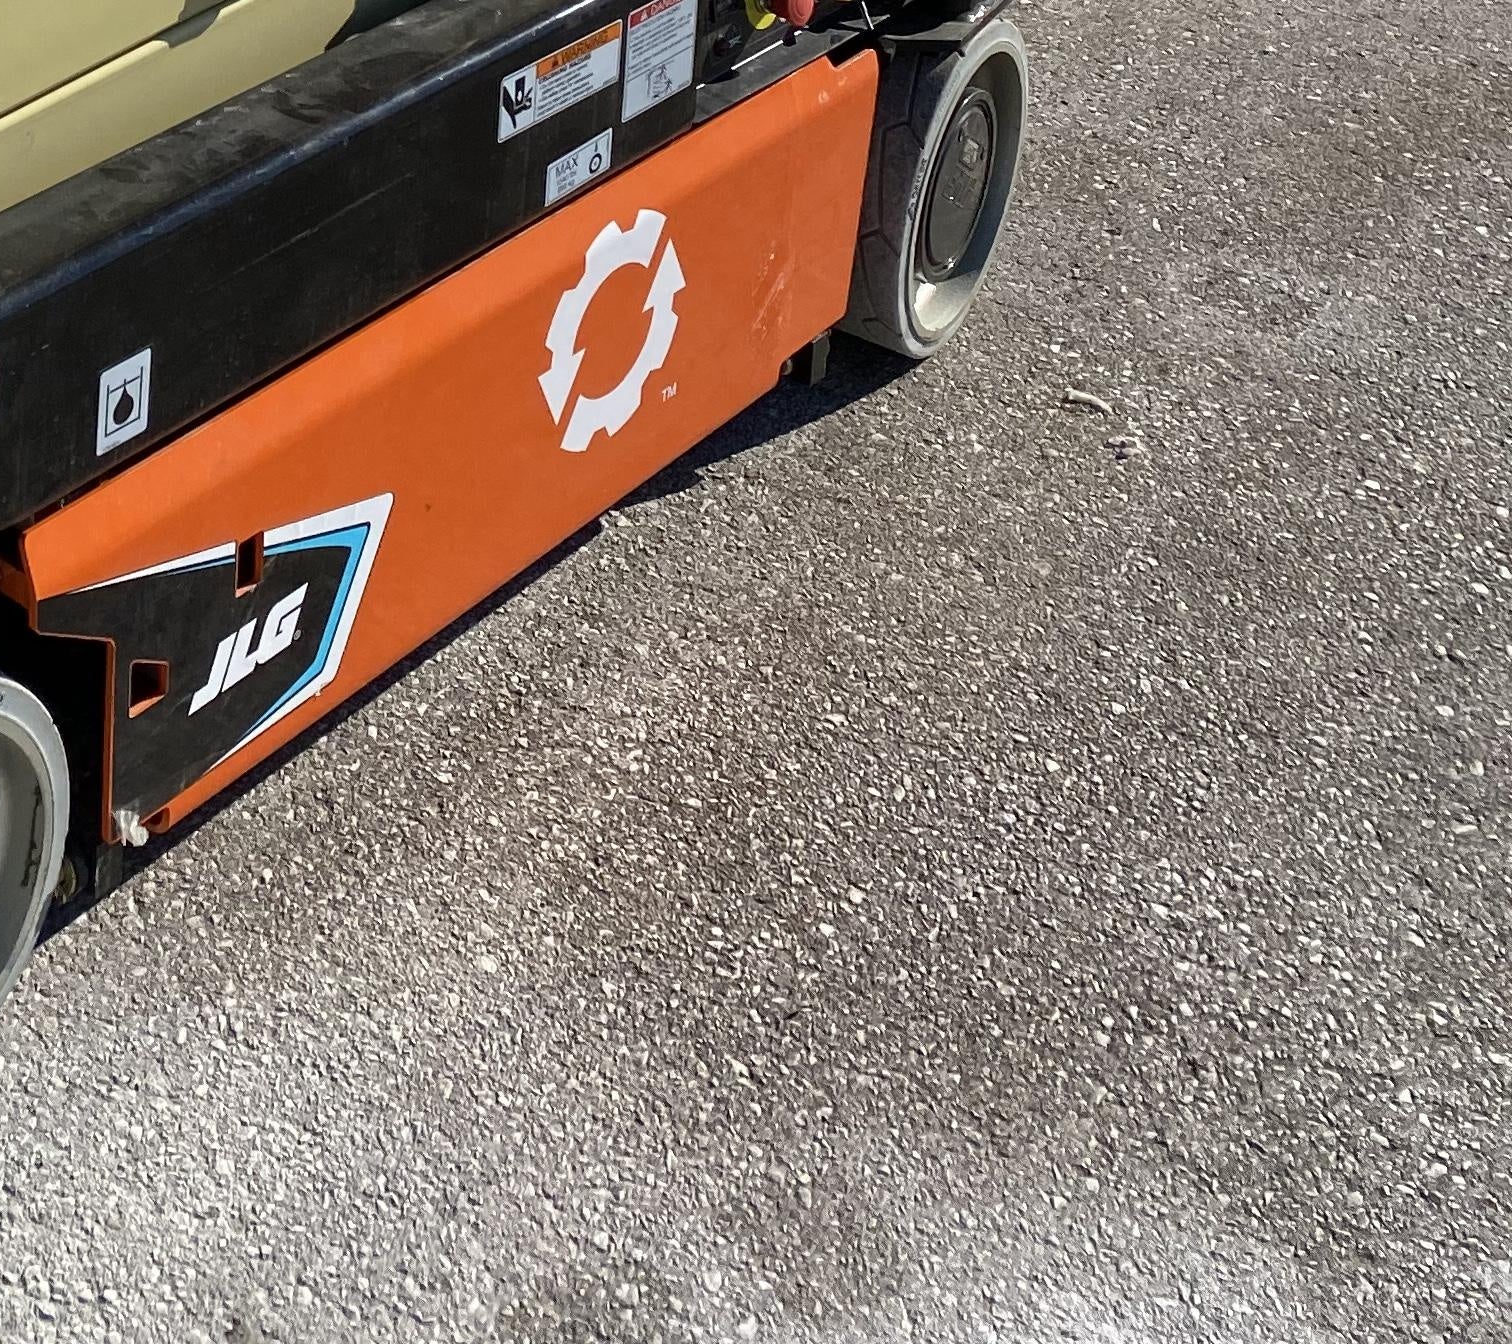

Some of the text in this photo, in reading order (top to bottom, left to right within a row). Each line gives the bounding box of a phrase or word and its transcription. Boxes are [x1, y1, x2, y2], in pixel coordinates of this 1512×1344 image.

[561, 29, 608, 63] WARNING
[555, 152, 580, 178] MAX
[661, 381, 677, 403] TM
[188, 582, 308, 716] JLG
